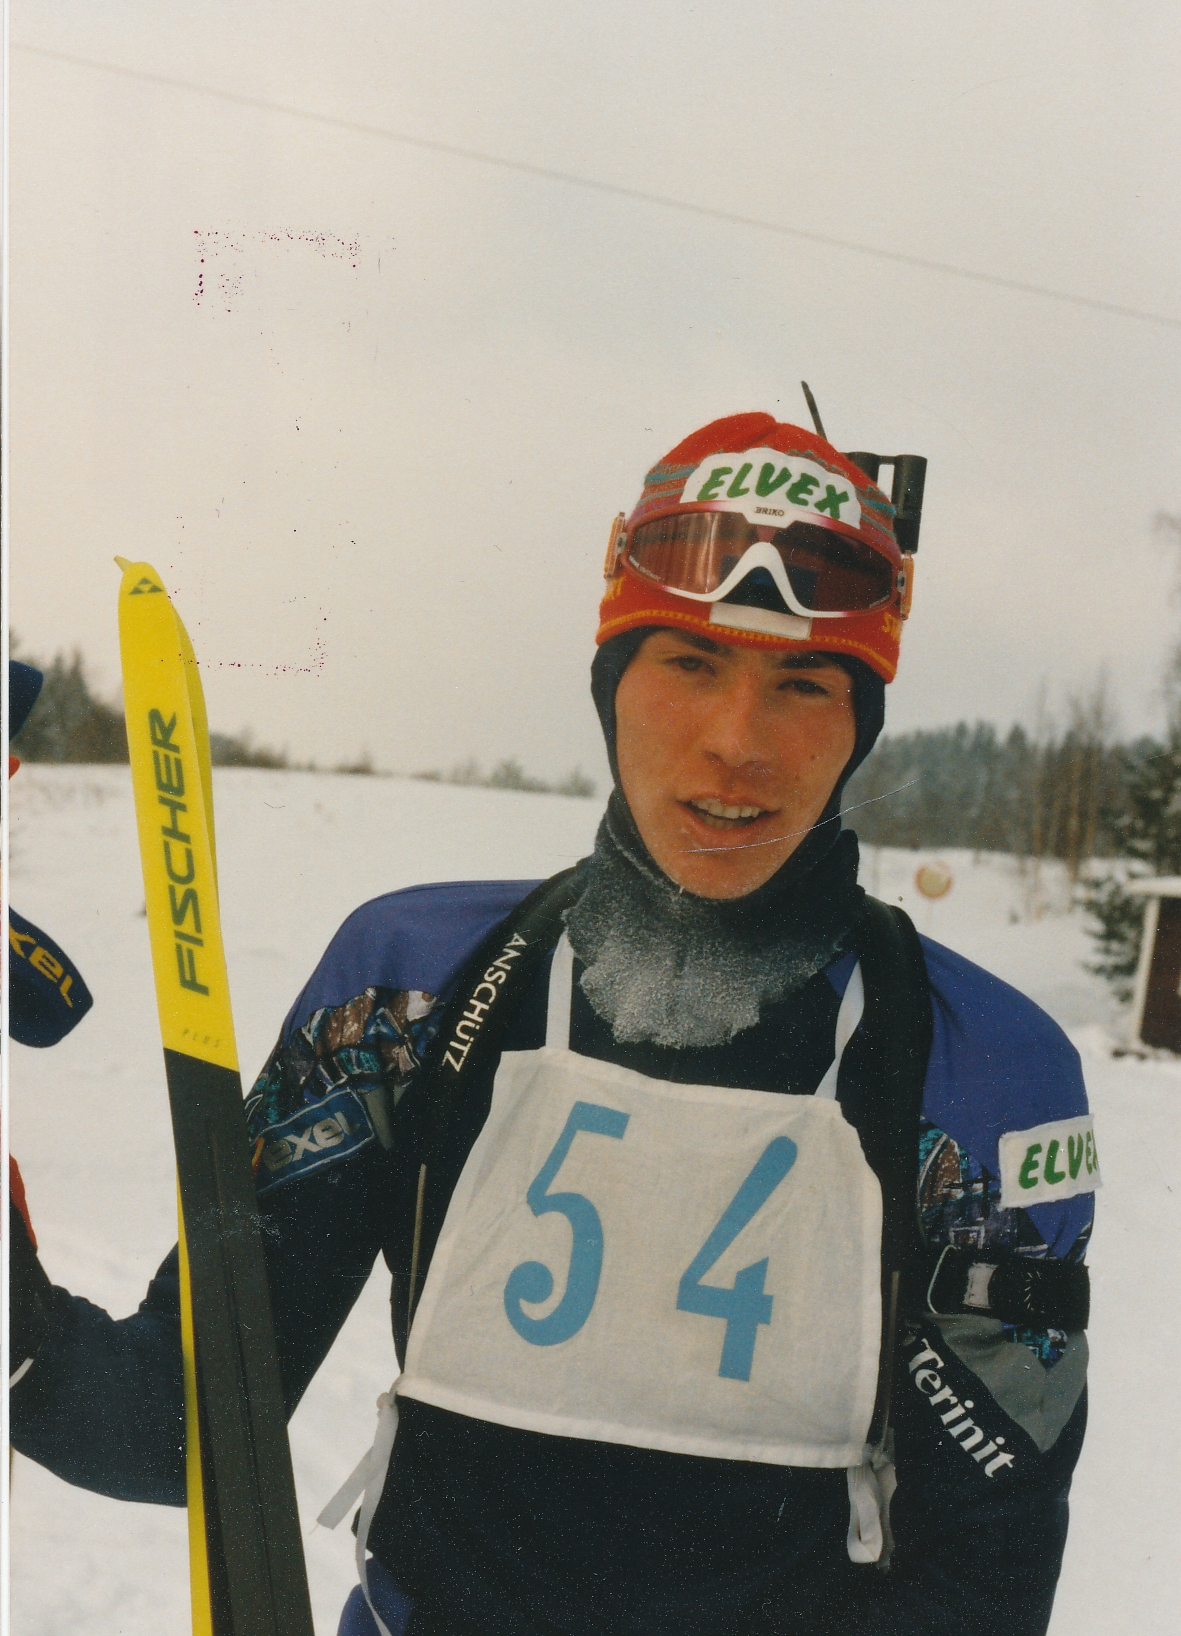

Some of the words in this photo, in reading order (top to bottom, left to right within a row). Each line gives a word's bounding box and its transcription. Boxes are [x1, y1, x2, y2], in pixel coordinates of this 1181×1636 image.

[696, 461, 850, 520] ELVEX
[754, 506, 785, 517] BRIKO
[147, 707, 210, 997] FISCHER
[441, 932, 528, 1073] ANSCHÜTZ
[261, 1110, 361, 1172] exel
[908, 1337, 1016, 1479] Terinit
